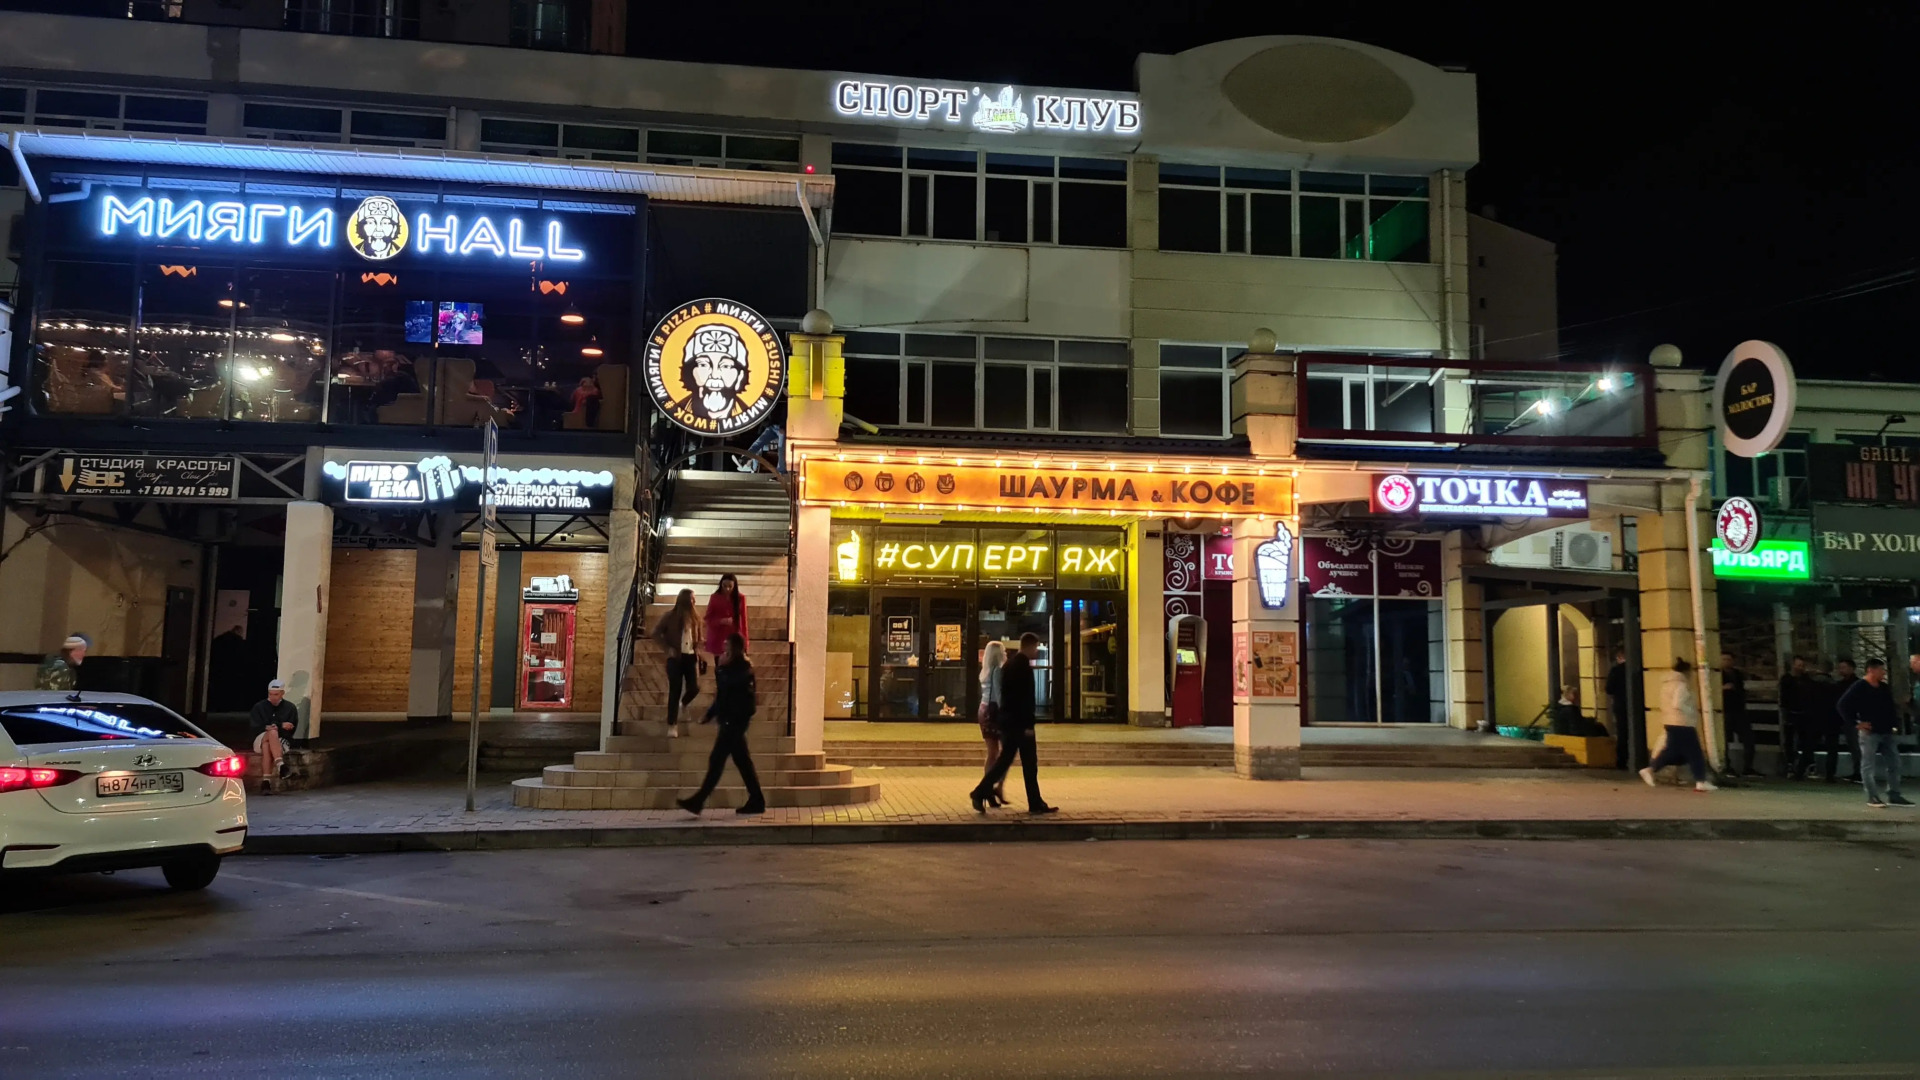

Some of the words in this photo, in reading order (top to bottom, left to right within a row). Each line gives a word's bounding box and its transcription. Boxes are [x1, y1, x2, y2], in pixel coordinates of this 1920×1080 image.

[838, 81, 968, 120] СПОРТ
[1034, 95, 1141, 133] КЛУБ
[101, 195, 333, 247] МИЯГИ
[417, 212, 585, 261] HALL
[79, 457, 145, 470] СТУДИЯ
[156, 459, 231, 471] КРАСОТЫ
[350, 464, 409, 482] ПИВО
[138, 486, 150, 495] +7
[153, 486, 174, 495] 978
[177, 487, 195, 496] 741
[208, 487, 229, 497] 999
[369, 479, 420, 498] ТЕКА
[495, 483, 578, 497] СУПЕРМАРКЕТ
[1000, 474, 1139, 503] ШАУРМА
[1171, 479, 1256, 506] КОФЕ
[1417, 476, 1549, 506] ТОЧКА
[479, 493, 557, 507] ЗЛИВНОГО
[558, 496, 591, 508] ПИВА
[1822, 531, 1866, 551] БАР
[1870, 533, 1920, 553] ХОЛ
